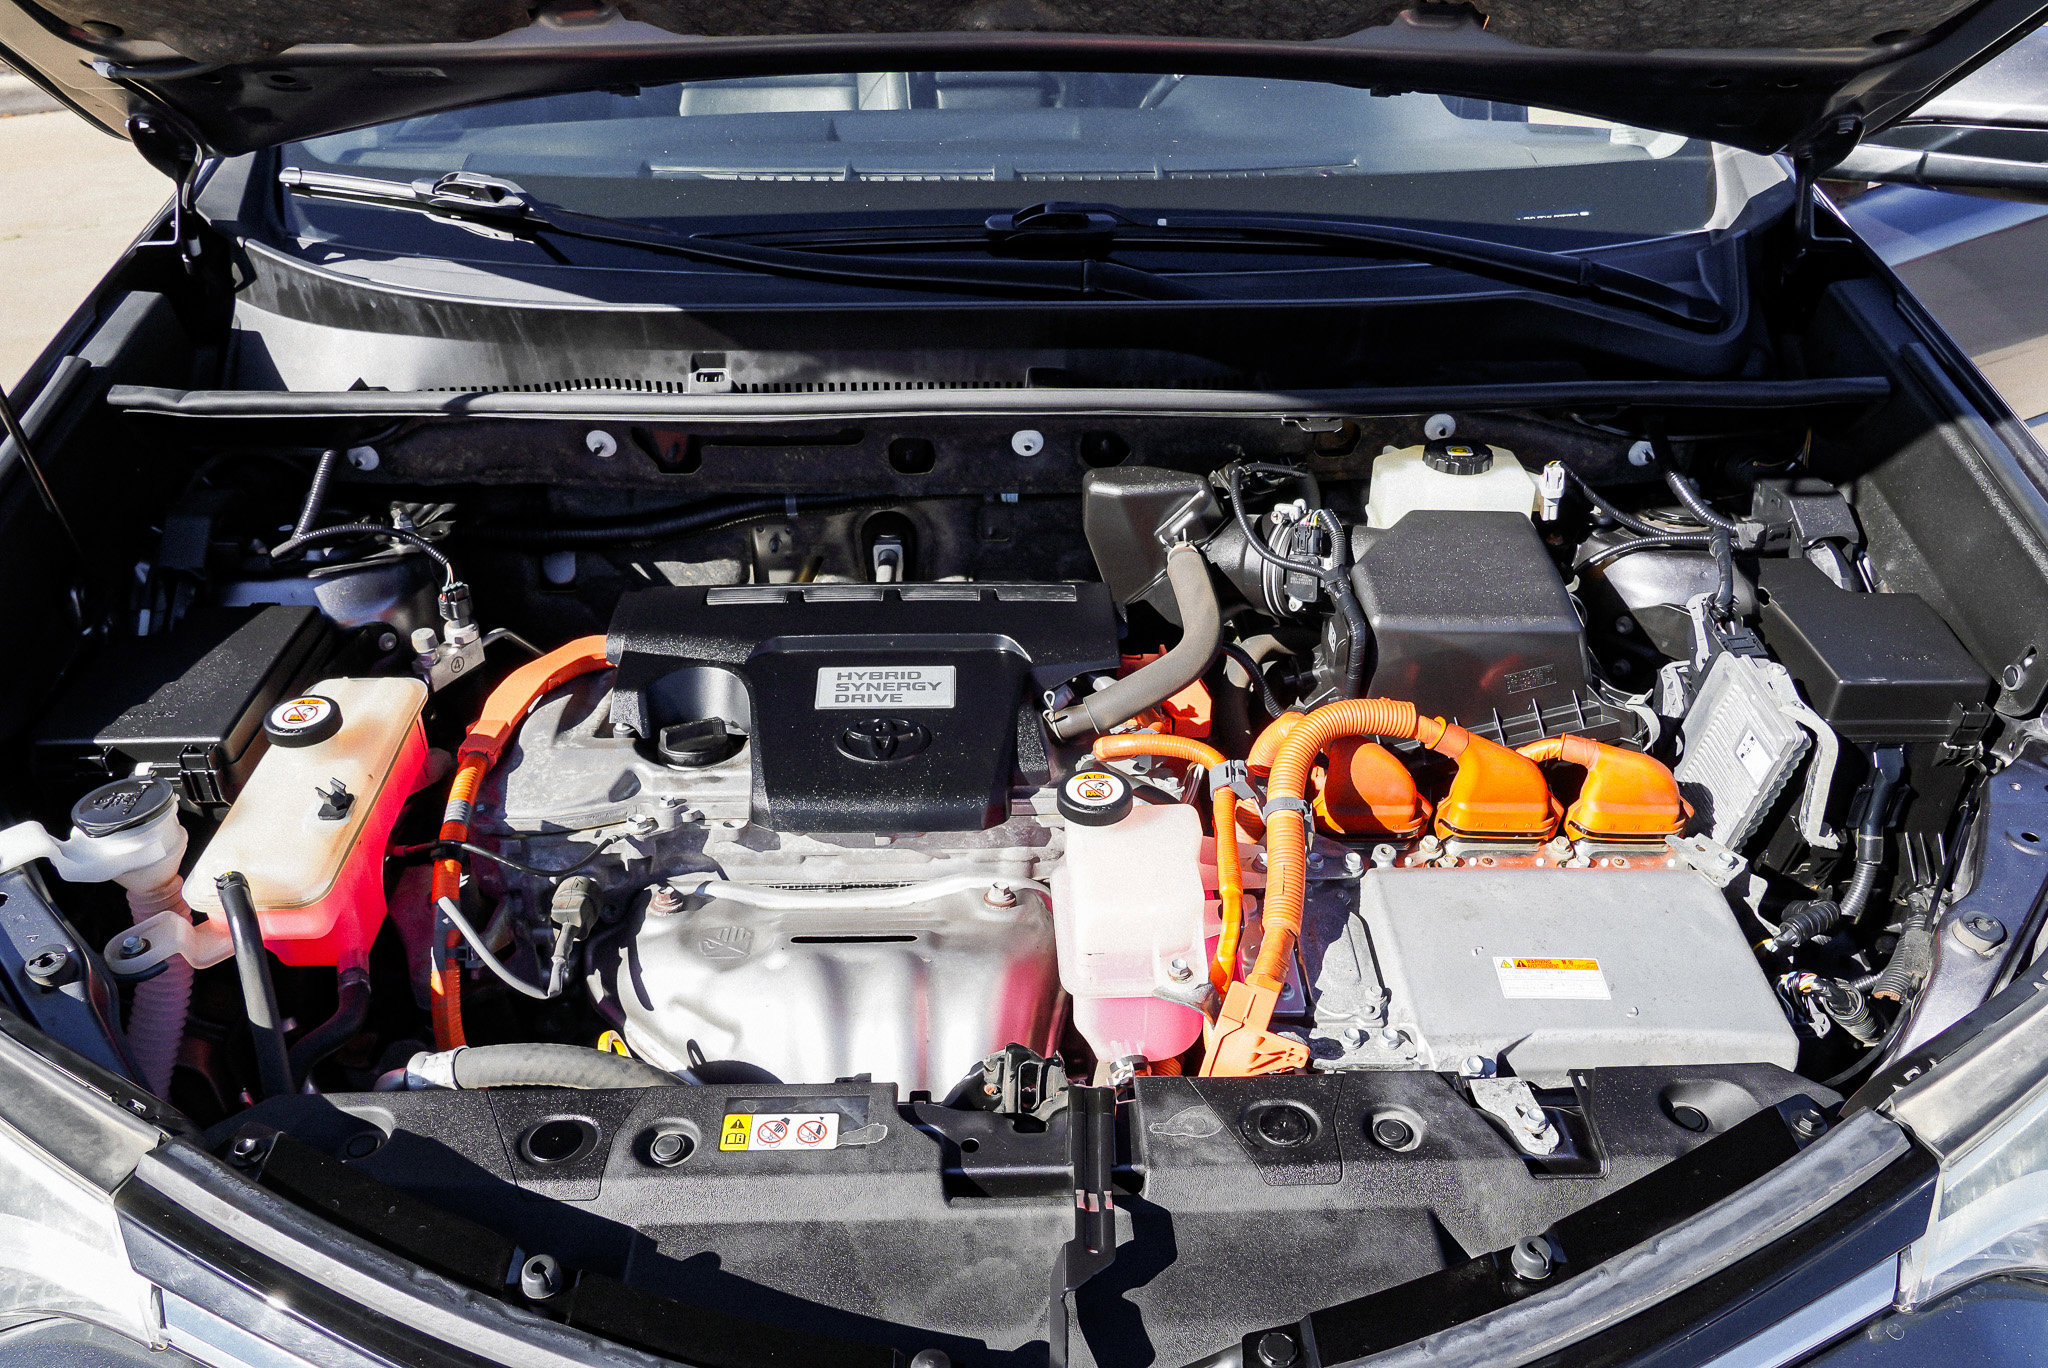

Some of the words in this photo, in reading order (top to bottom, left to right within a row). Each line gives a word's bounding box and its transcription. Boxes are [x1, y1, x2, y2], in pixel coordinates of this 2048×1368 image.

[836, 671, 921, 681] HYBRID
[835, 681, 942, 692] SYNERGY
[834, 693, 903, 703] DRIVE
